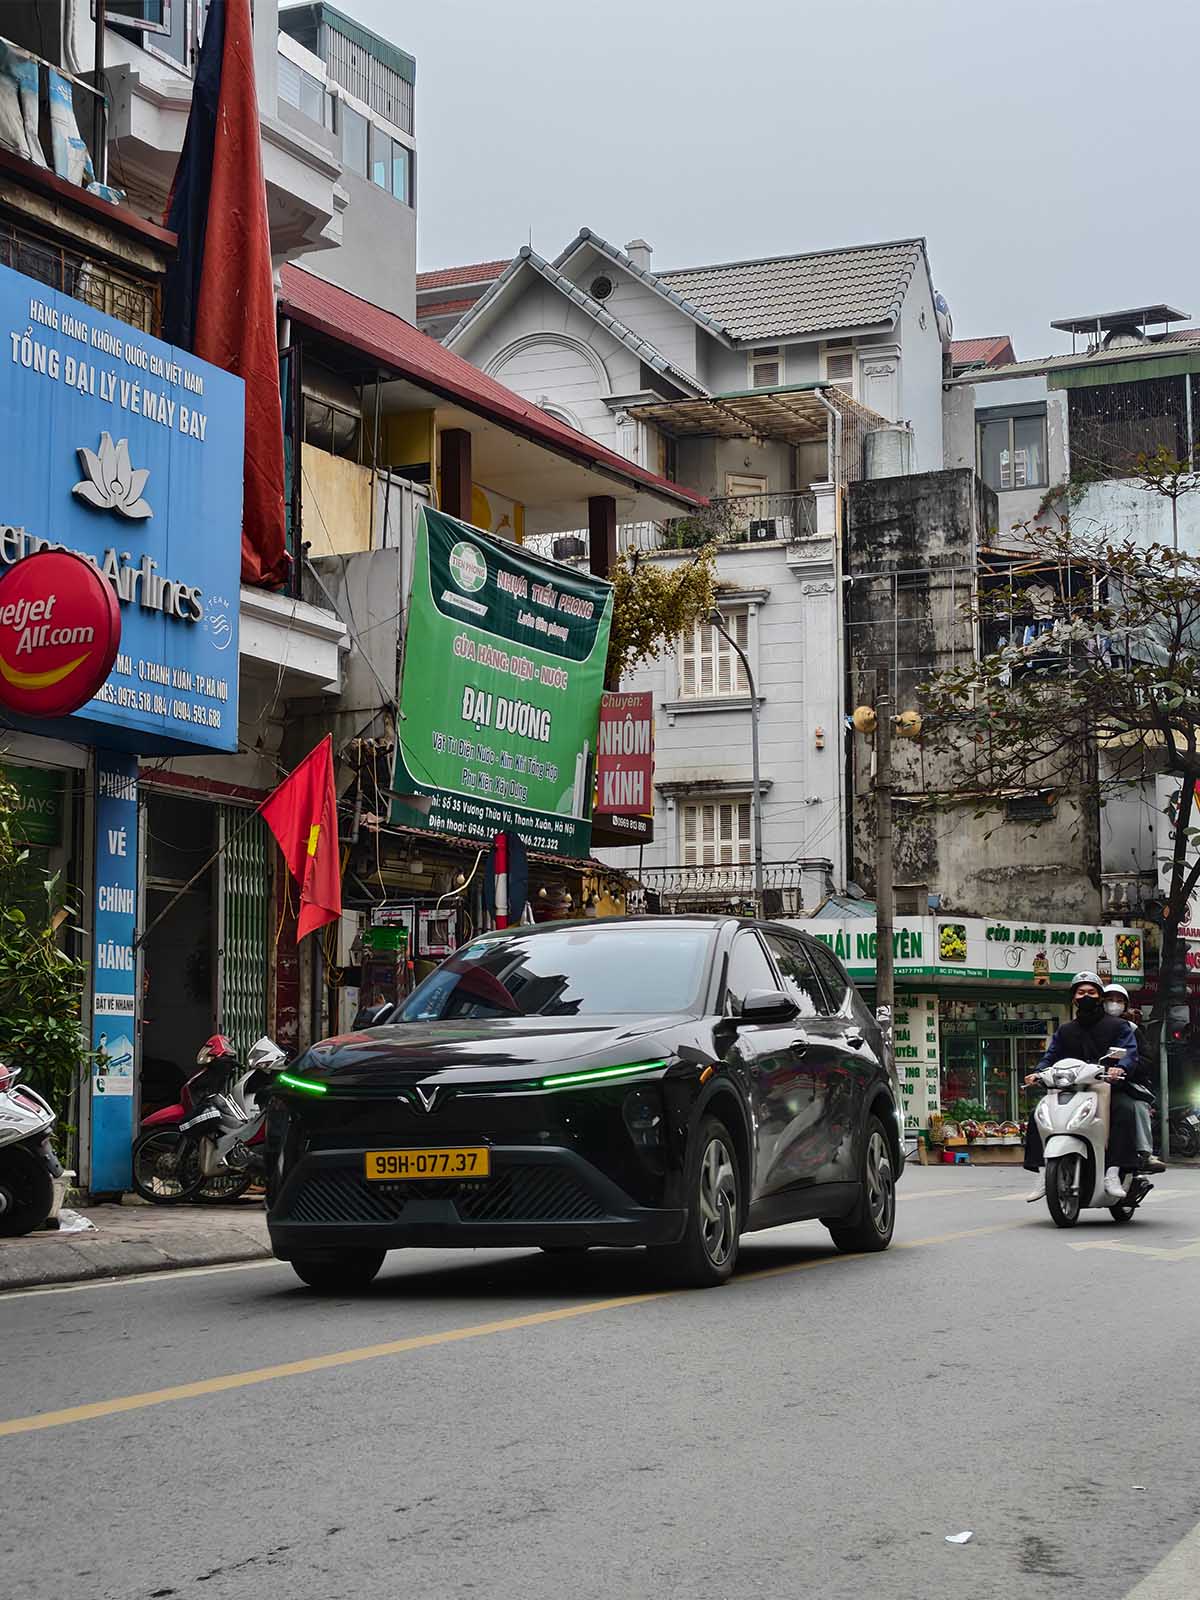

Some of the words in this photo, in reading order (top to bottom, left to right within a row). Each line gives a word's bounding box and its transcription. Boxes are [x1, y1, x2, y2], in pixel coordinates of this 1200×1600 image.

[29, 299, 58, 330] HÀNG
[61, 312, 88, 342] HÀNG
[91, 327, 122, 358] KHÔNG
[150, 357, 163, 377] GIA
[184, 371, 203, 395] NAM
[10, 326, 60, 380] TỔNG
[65, 355, 95, 396] ĐẠI
[100, 370, 118, 403] LÝ
[120, 379, 140, 413] VÉ
[143, 390, 175, 428] MÁY
[179, 405, 208, 441] BAY
[103, 548, 203, 623] Airlines
[558, 594, 594, 619] PHONG
[138, 659, 170, 686] Q.THANH
[462, 687, 491, 731] ĐẠI
[495, 697, 551, 742] DƯƠNG
[601, 694, 644, 711] Chuyên:
[600, 713, 650, 755] NHÔM
[99, 769, 137, 801] PHÒNG
[603, 763, 645, 806] KÍNH
[452, 800, 461, 812] 35
[108, 827, 127, 857] VÉ
[99, 883, 134, 914] CHÍNH
[98, 940, 133, 971] HÃNG
[857, 928, 922, 960] NGYÊN
[376, 1153, 478, 1174] 99H-077.37
